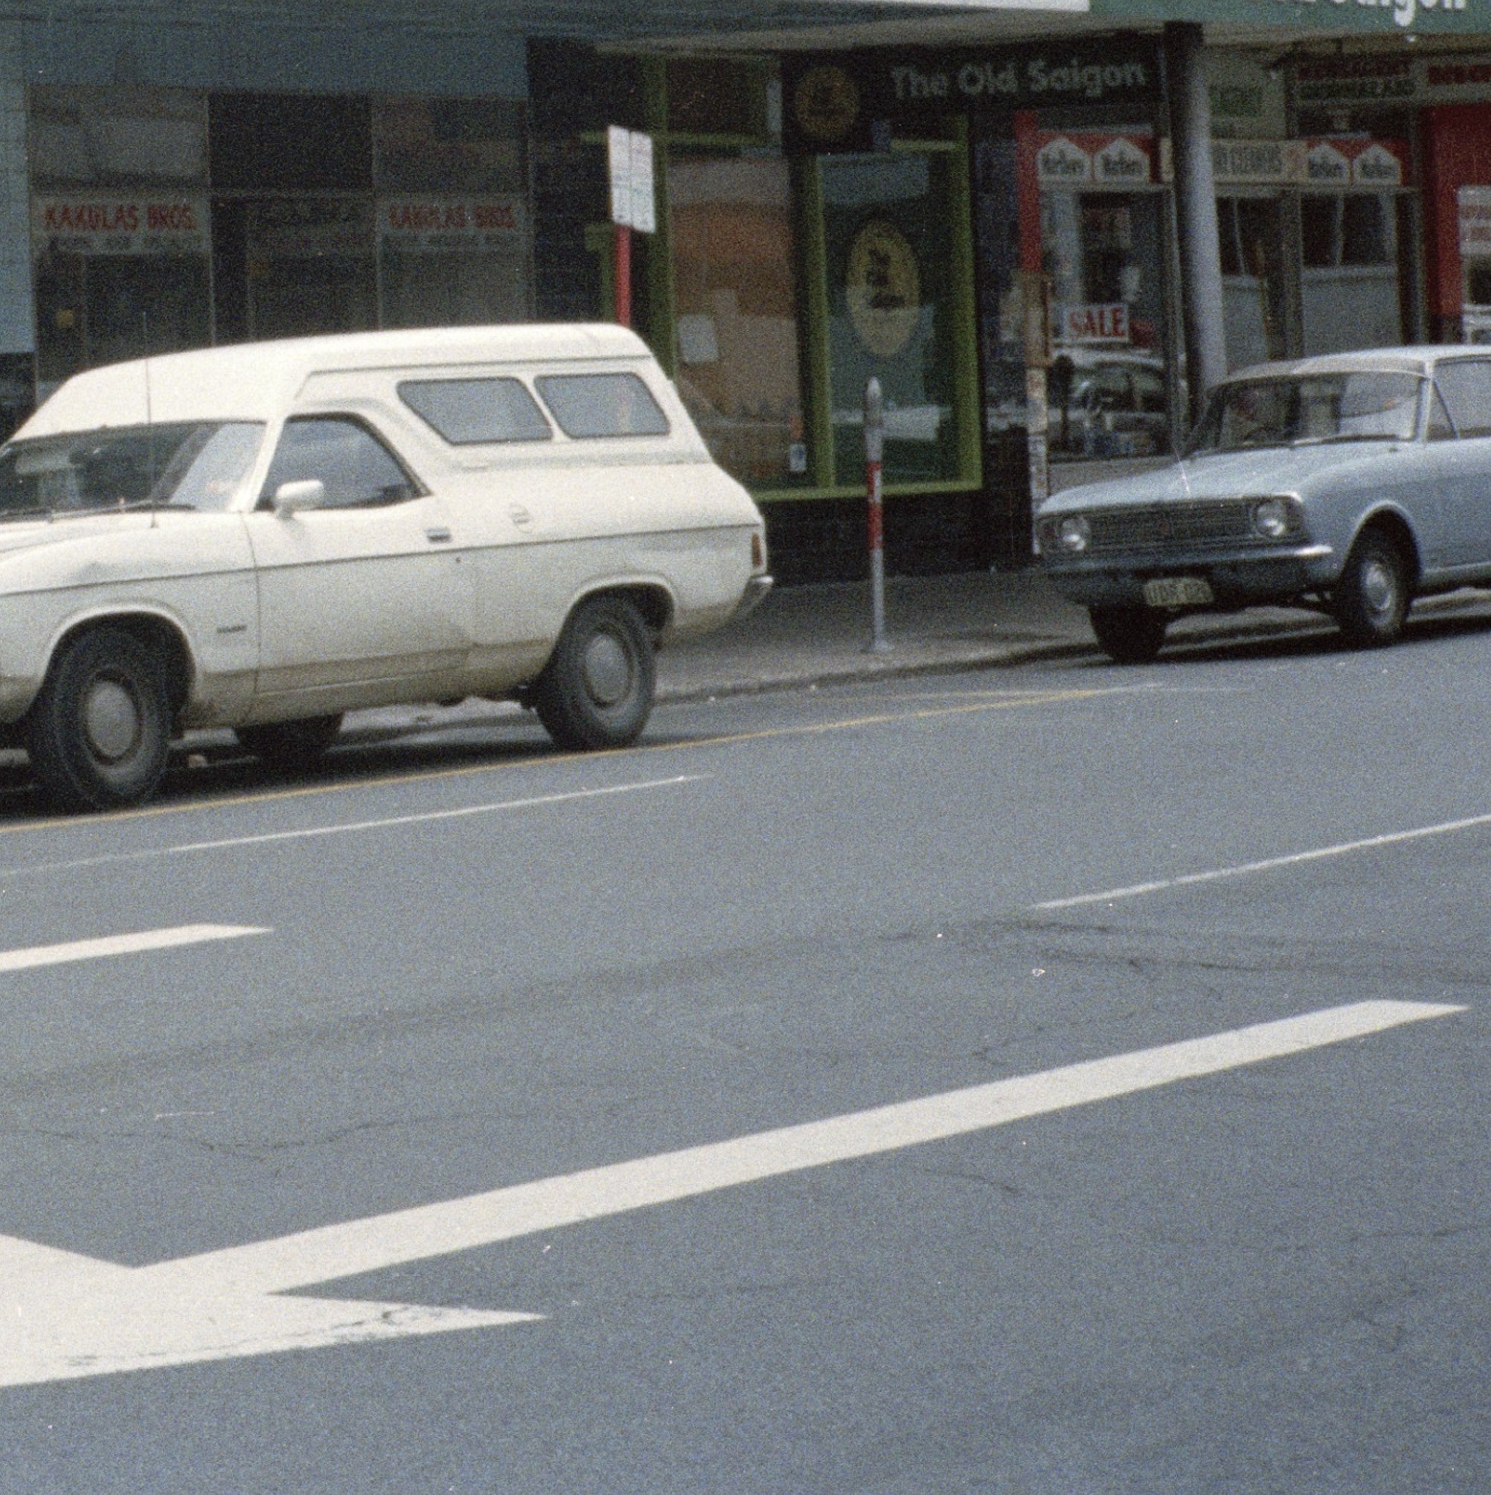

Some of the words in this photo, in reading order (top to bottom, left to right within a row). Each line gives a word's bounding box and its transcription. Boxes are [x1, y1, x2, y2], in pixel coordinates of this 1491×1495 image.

[890, 65, 950, 99] The
[958, 61, 1021, 96] Old
[1026, 57, 1147, 98] Saigon
[44, 204, 139, 231] KAKULAS
[1069, 306, 1126, 339] SALE
